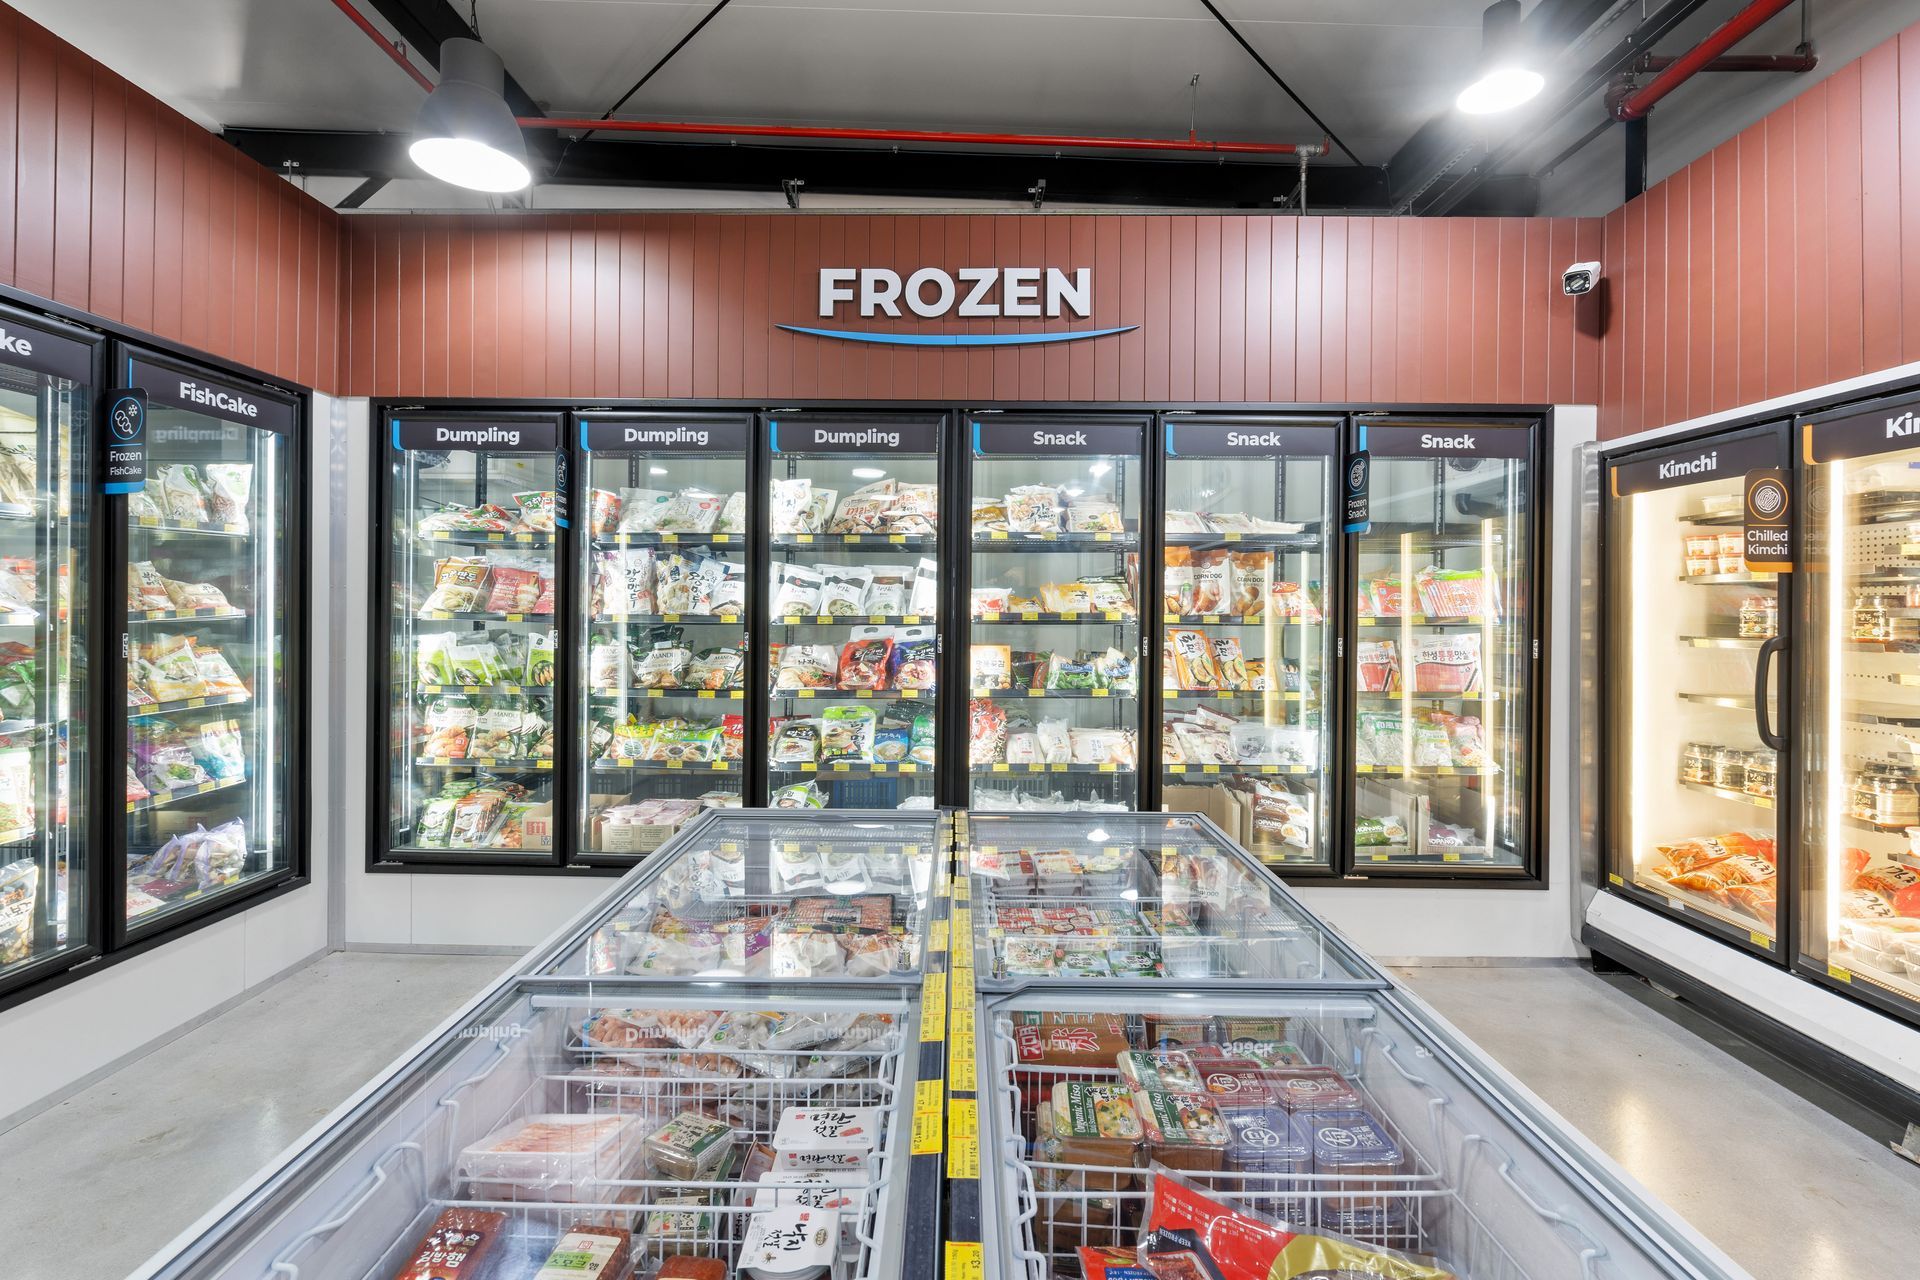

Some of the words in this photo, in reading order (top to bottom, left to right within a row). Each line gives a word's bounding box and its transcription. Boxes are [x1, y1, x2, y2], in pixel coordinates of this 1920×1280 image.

[819, 267, 1090, 317] FROZEN
[180, 381, 258, 418] FishCake
[436, 427, 520, 446] Dumpling
[624, 427, 708, 446] Dumpling
[814, 428, 900, 447] Dumpling
[1032, 431, 1087, 446] Snack
[1226, 431, 1281, 447] Snack
[1420, 432, 1476, 450] Snack
[110, 450, 142, 462] Frozen
[110, 466, 142, 476] FishCake
[1659, 452, 1717, 480] Kimchi
[1348, 498, 1368, 508] Frozen
[1348, 509, 1368, 519] Snack
[1748, 530, 1788, 542] Chilled
[1748, 544, 1788, 556] Kimchi
[1020, 1026, 1040, 1056] プロ用
[1070, 1084, 1082, 1105] Miso
[1152, 1093, 1164, 1111] Miso
[1072, 1104, 1087, 1132] Organic
[1160, 1227, 1179, 1242] FROZEN
[1178, 1236, 1192, 1248] KEEP
